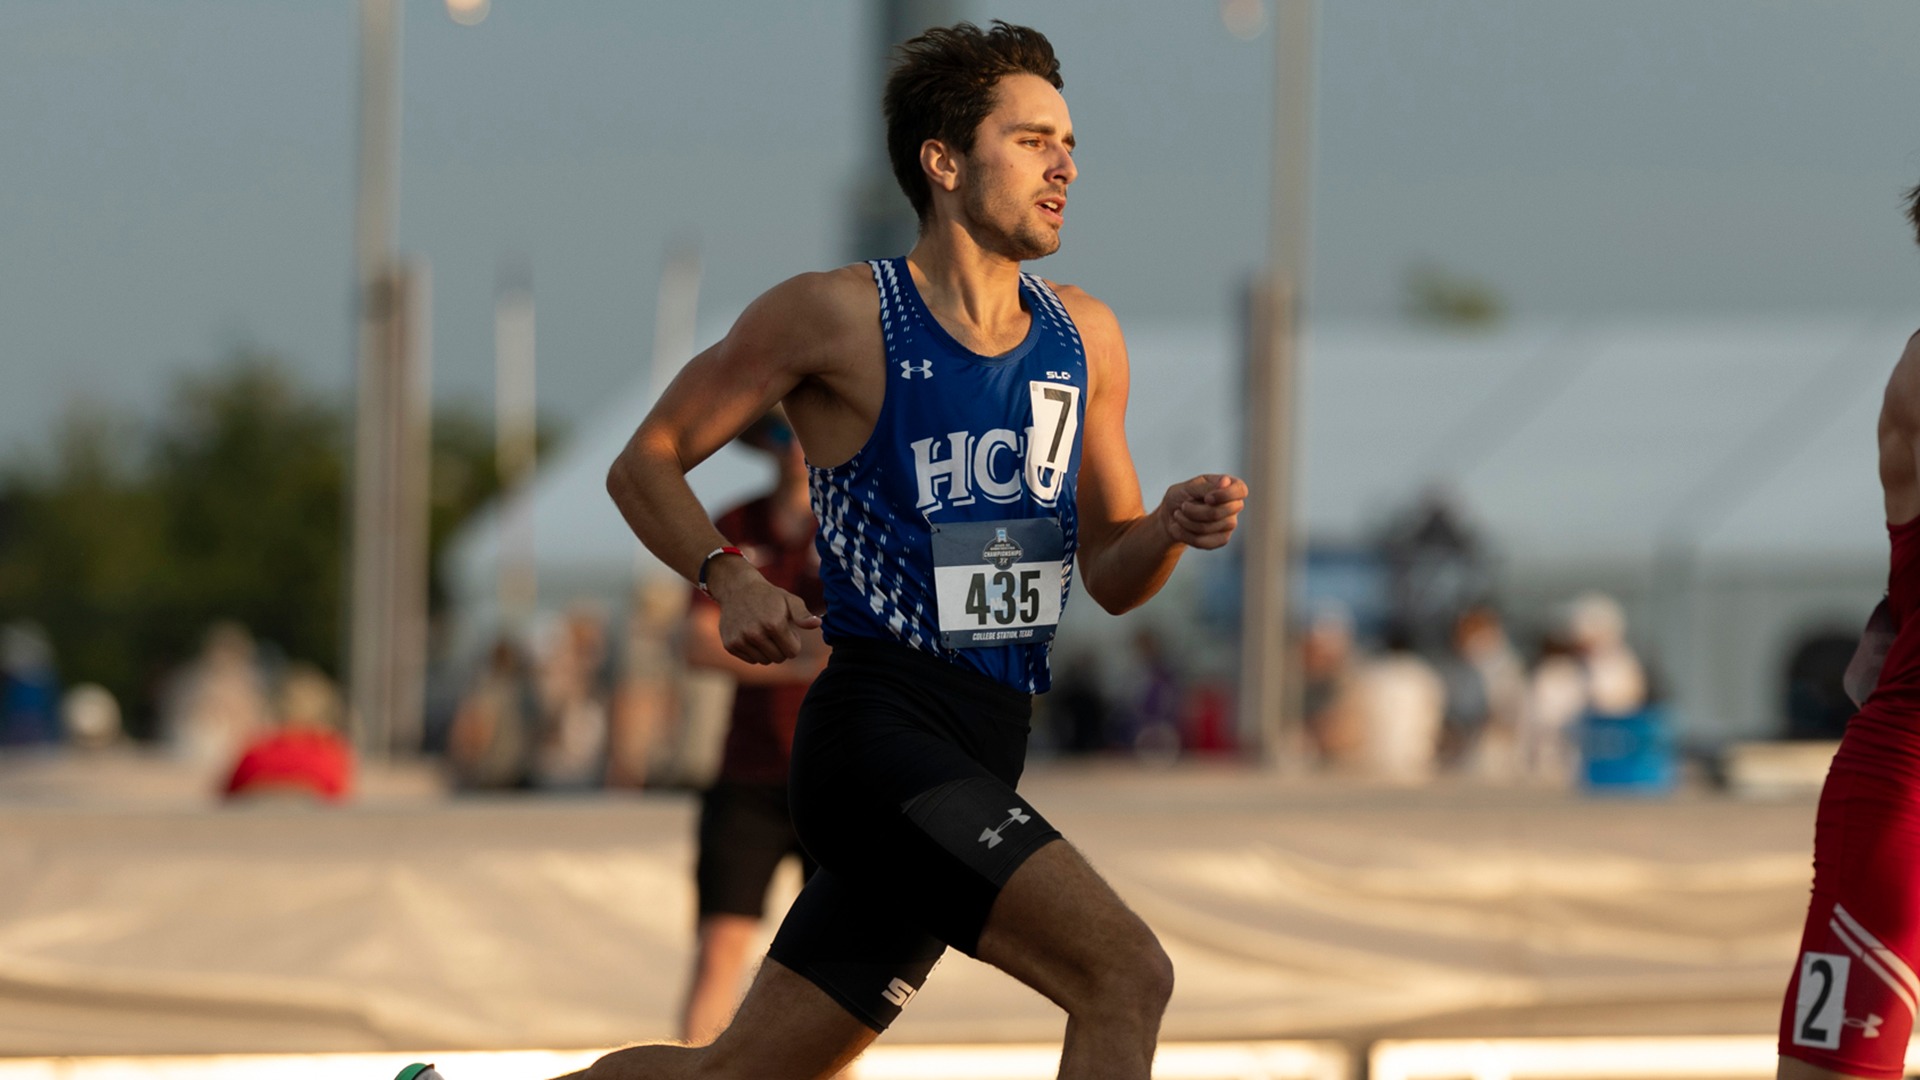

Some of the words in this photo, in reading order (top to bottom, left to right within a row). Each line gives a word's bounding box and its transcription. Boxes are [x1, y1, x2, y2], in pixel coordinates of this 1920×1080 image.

[1043, 387, 1072, 464] 7
[965, 570, 1041, 625] 435
[972, 632, 996, 641] COLLEGE
[1018, 629, 1033, 638] TEXAS
[1801, 959, 1833, 1042] 2
